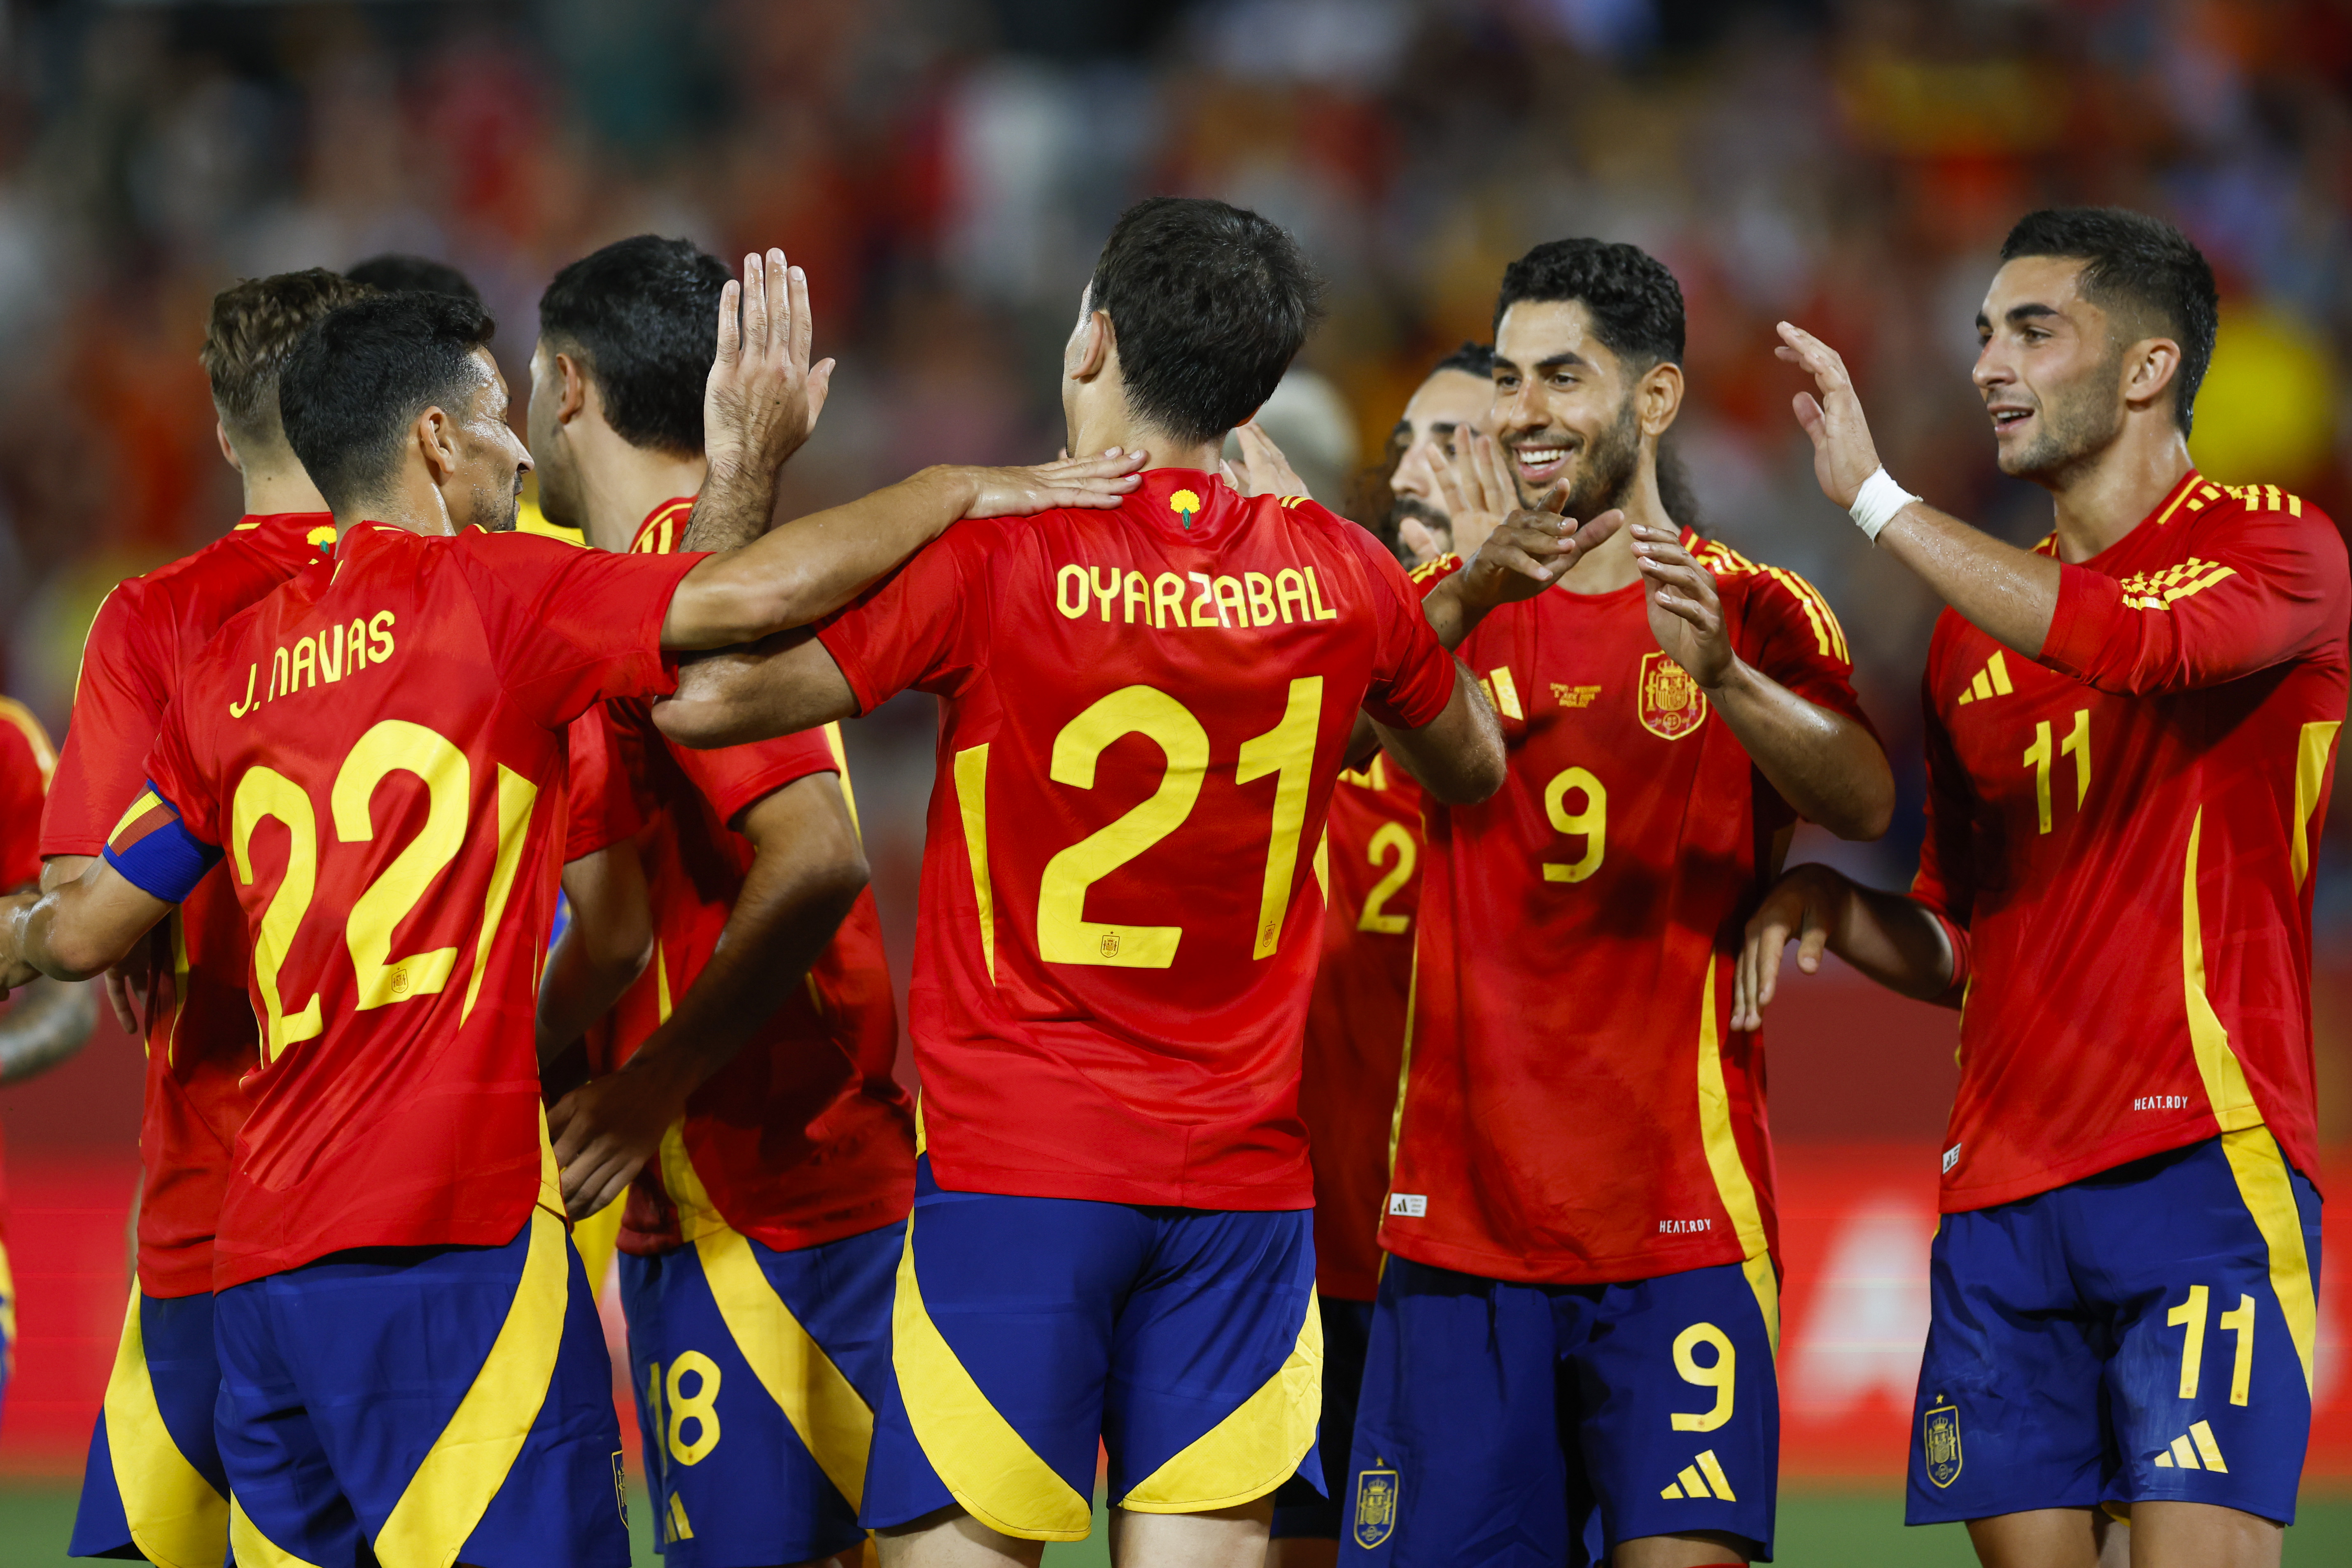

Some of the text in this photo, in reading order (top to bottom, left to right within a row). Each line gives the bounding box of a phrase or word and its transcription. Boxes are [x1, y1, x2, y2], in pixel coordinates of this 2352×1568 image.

[1057, 564, 1337, 629] OYARZABAL
[230, 610, 395, 719] J. NAVAS
[1037, 675, 1323, 968] 21
[1542, 766, 1607, 883] 9
[2023, 709, 2091, 835] 11
[232, 719, 470, 1063] 22
[1357, 822, 1417, 934] 2
[2134, 1095, 2188, 1111] HEAT.RDY
[1659, 1218, 1711, 1233] HEAT.RDY
[1670, 1322, 1736, 1432] 9
[2167, 1284, 2256, 1407] 11
